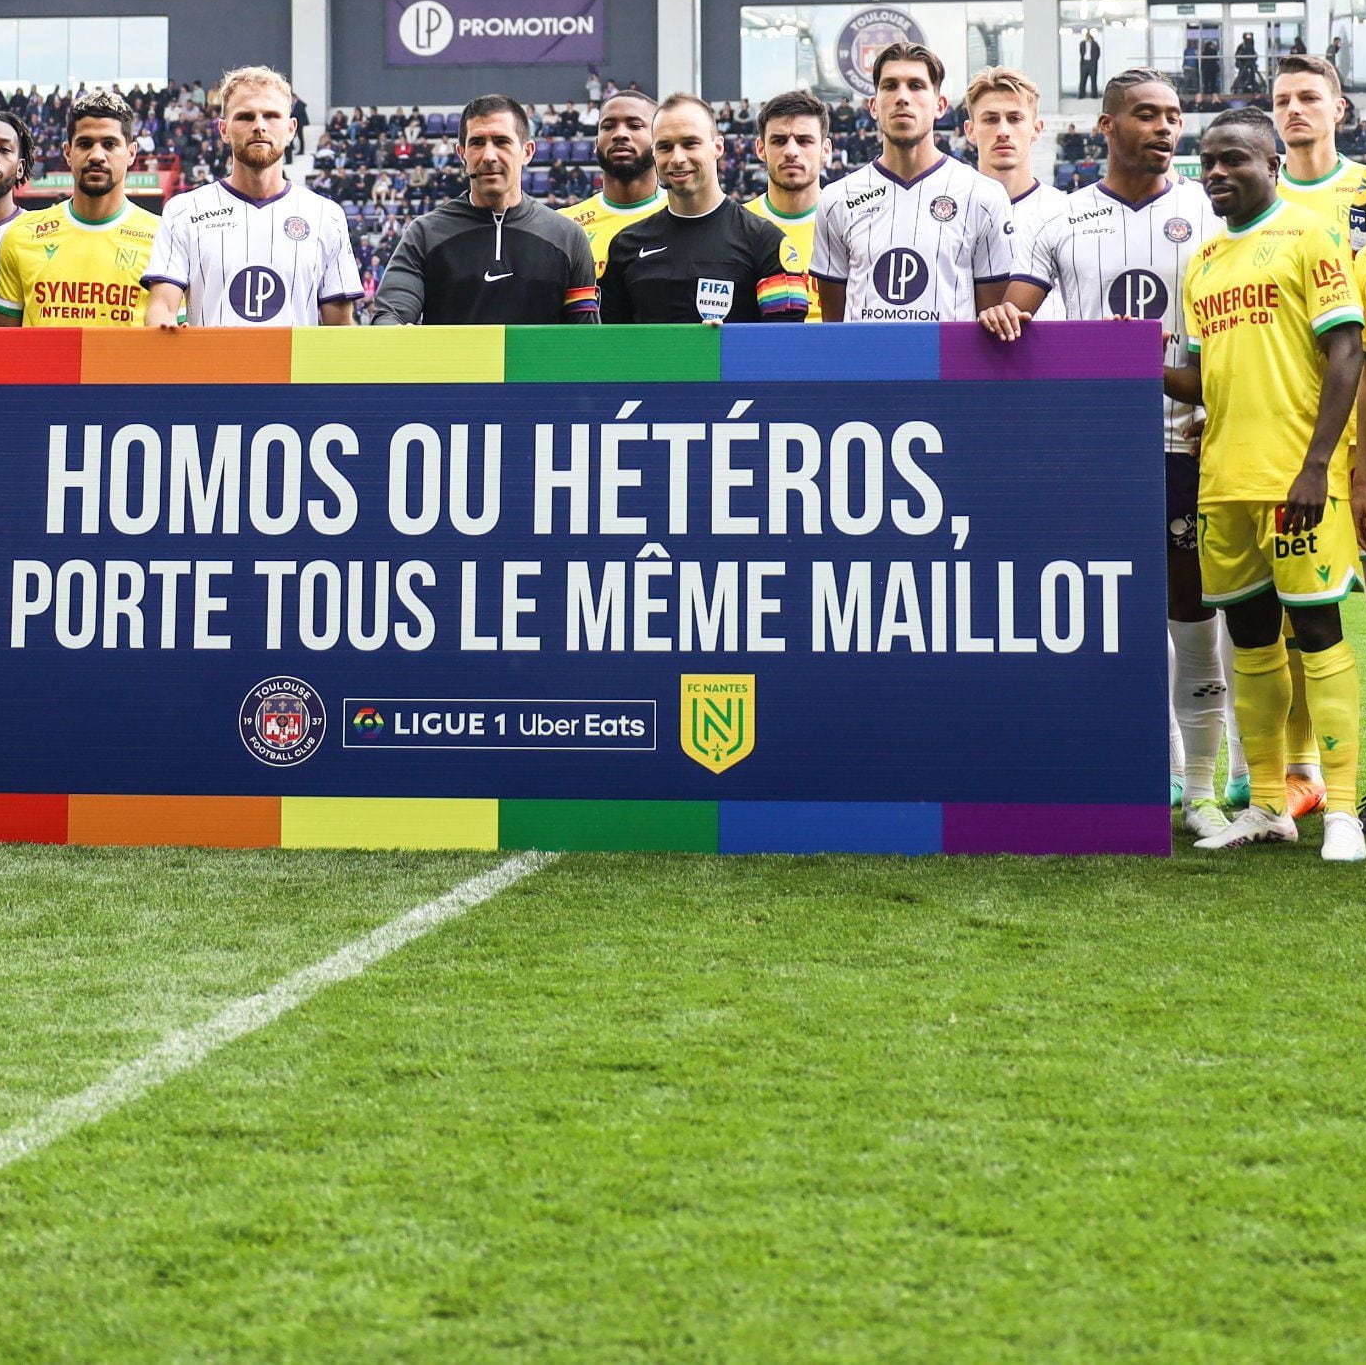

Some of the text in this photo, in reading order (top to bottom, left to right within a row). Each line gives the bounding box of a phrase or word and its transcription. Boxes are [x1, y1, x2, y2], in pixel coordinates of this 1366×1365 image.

[459, 15, 594, 38] PROMOTION
[850, 12, 913, 31] TOULOUSE
[846, 186, 886, 209] betway
[190, 206, 234, 224] betway
[1068, 206, 1113, 225] betway
[1351, 214, 1366, 224] LFP
[36, 220, 60, 234] AFD
[35, 281, 141, 307] SYNERGIE
[701, 282, 730, 295] FIFA
[699, 299, 729, 308] REFEREE
[1193, 284, 1279, 324] SYNERGIE
[111, 309, 134, 322] CDI
[861, 308, 940, 322] PROMOTION
[1250, 311, 1274, 325] CDI
[45, 400, 970, 551] HOMOS OU HÉTÉROS,
[1275, 532, 1317, 559] bet
[10, 560, 233, 649] PORTE
[254, 560, 436, 651] TOUS
[460, 561, 542, 651] LE
[566, 543, 786, 652] MÊME
[812, 560, 1133, 653] MAILLOT
[255, 681, 312, 700] TOULOUSE
[687, 683, 748, 694] FC NANTES
[243, 716, 323, 726] 19 37
[394, 713, 646, 736] LIGUE 1 Uber Eats
[249, 736, 316, 761] FOOTBALL CLUB
